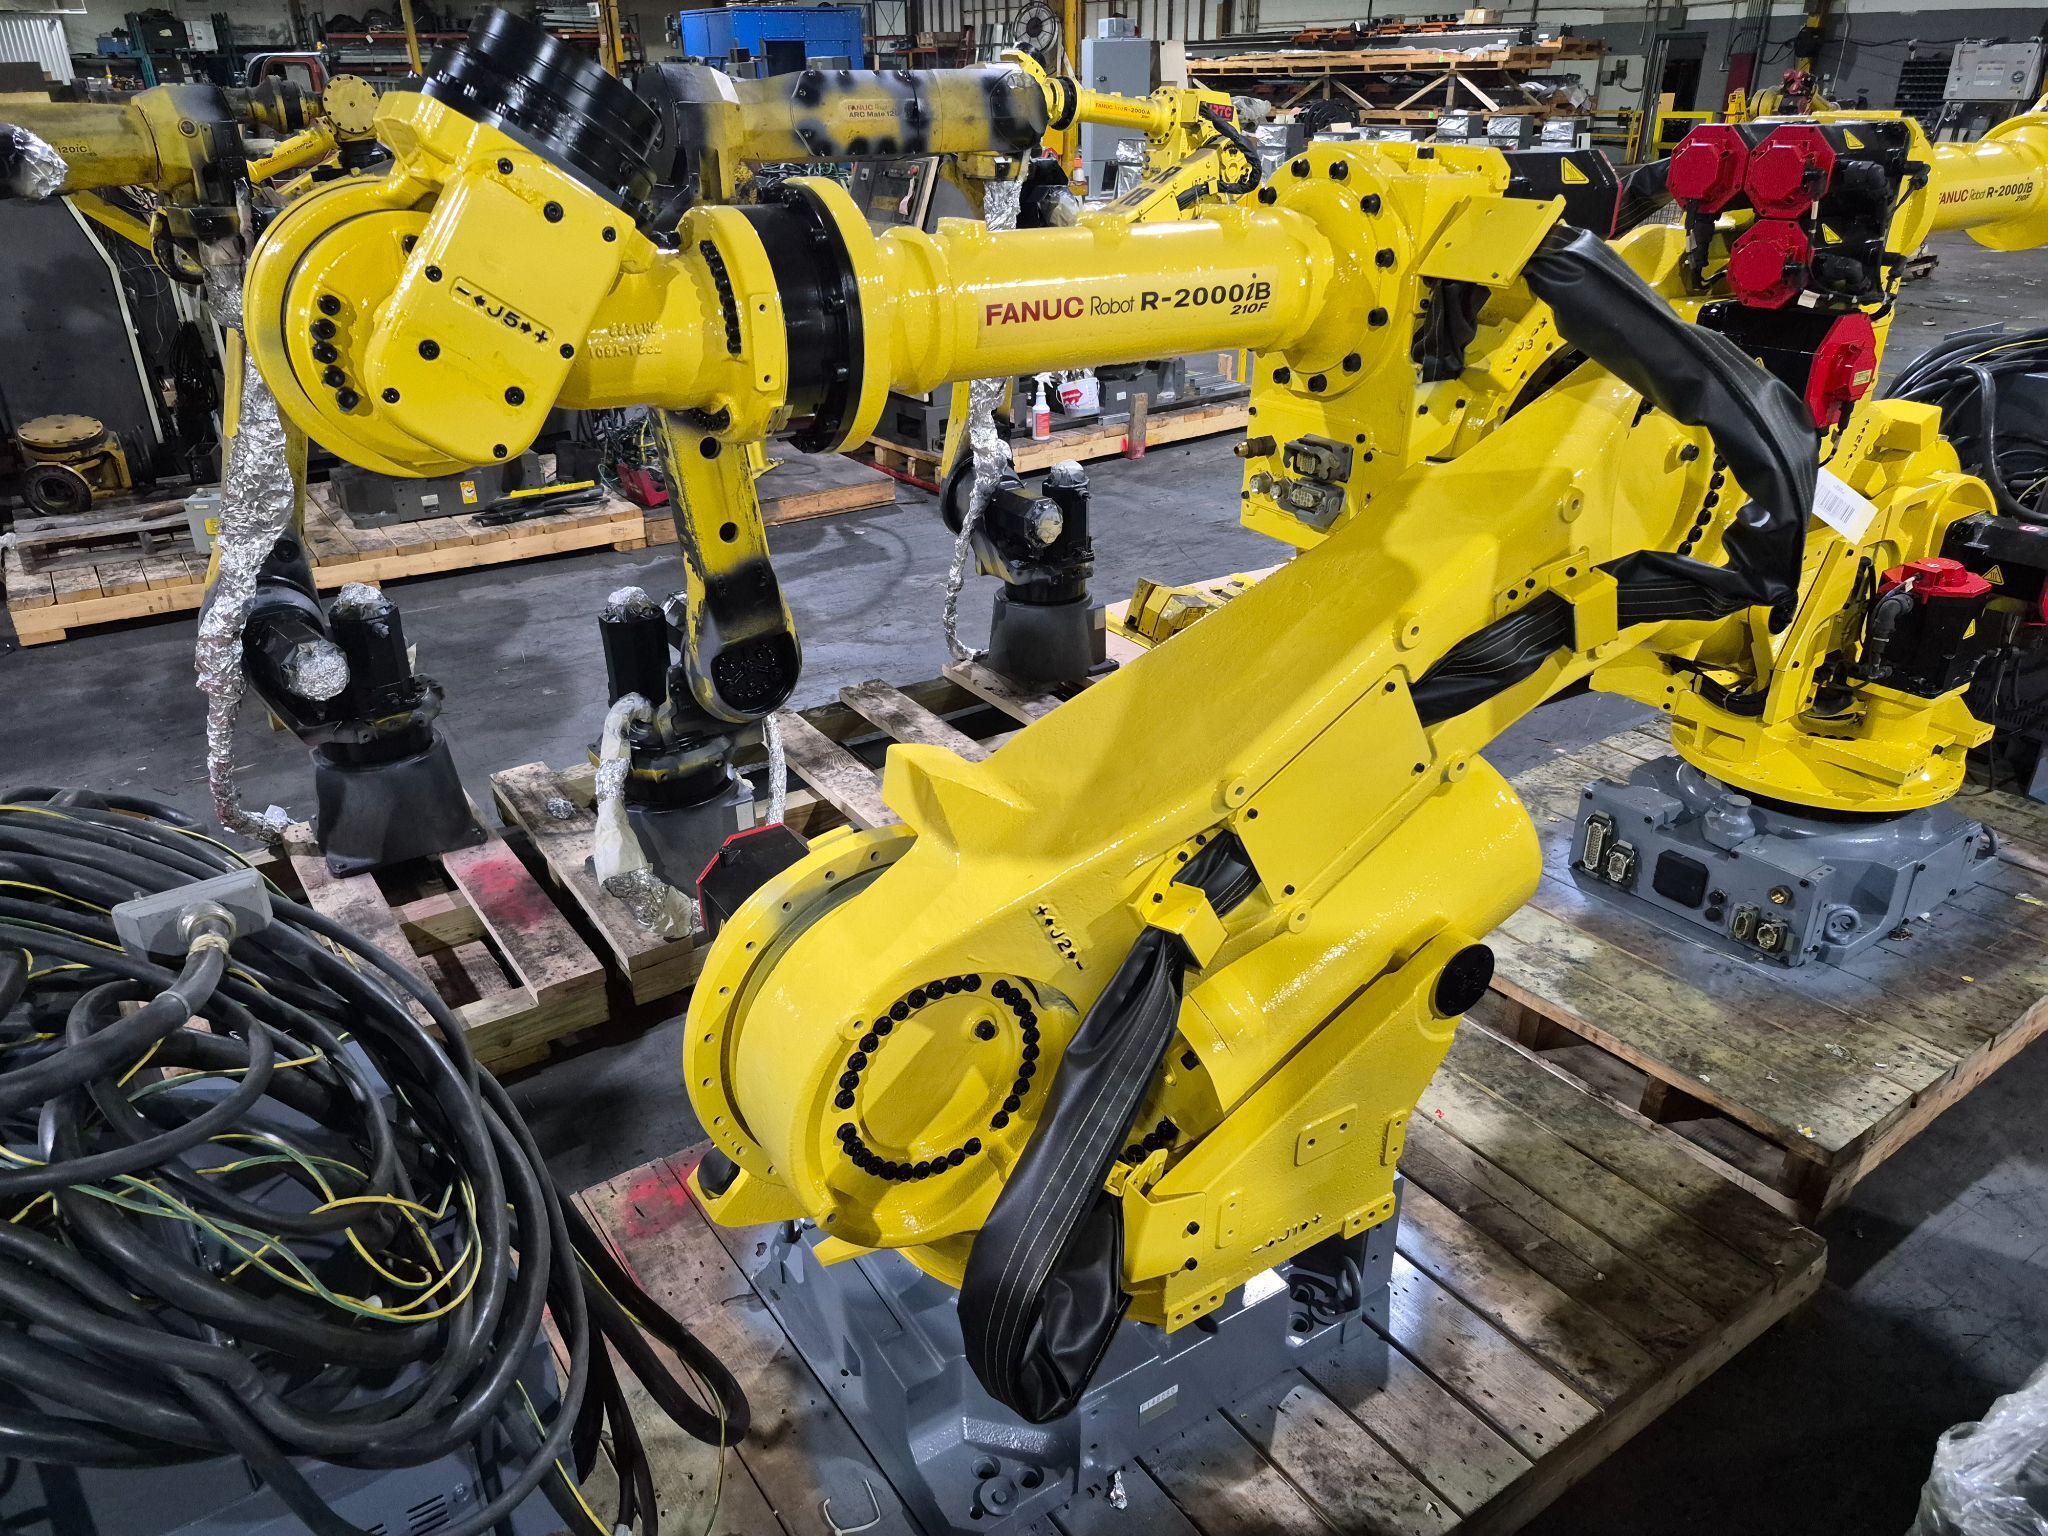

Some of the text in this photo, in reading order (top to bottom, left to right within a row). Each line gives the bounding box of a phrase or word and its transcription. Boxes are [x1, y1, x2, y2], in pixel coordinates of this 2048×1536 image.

[986, 273, 1271, 326] FANUC Robot R-2000iB
[1230, 301, 1270, 316] 210F
